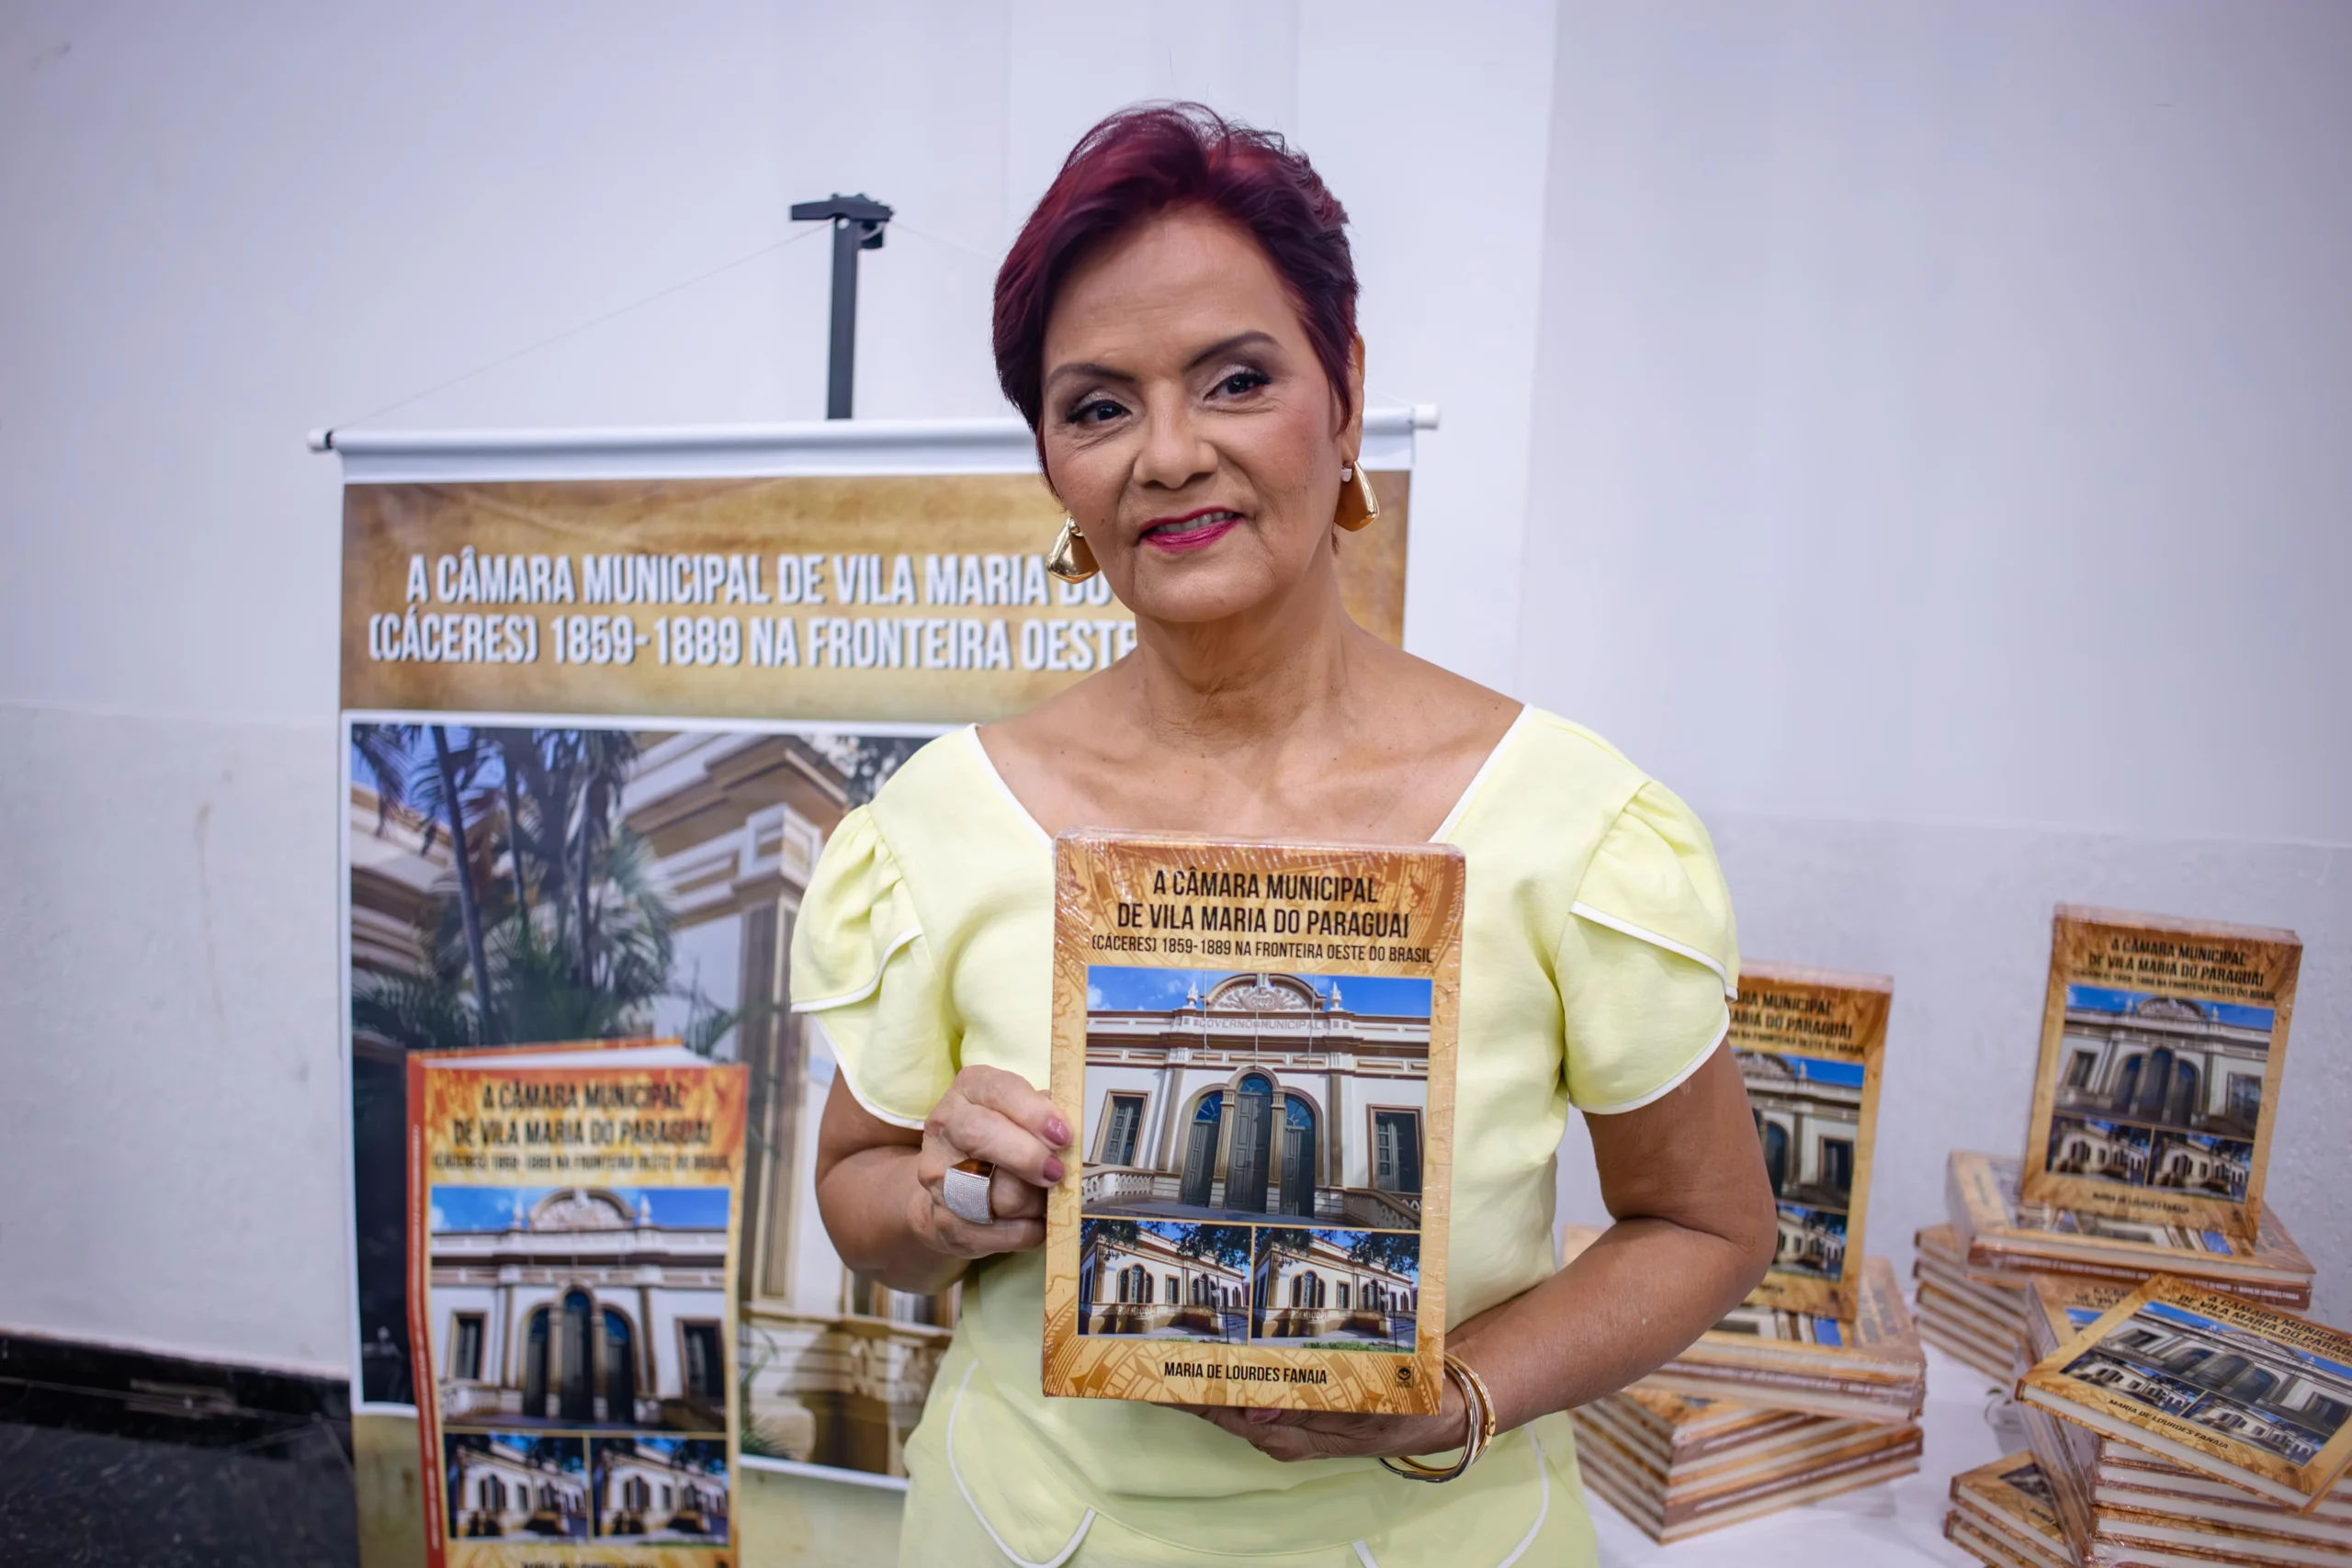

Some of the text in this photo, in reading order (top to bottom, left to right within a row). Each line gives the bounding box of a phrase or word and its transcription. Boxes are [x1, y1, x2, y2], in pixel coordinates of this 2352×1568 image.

[406, 554, 429, 604] A
[436, 546, 576, 604] CÂMARA
[582, 554, 770, 604] MUNICIPAL
[777, 555, 825, 605] DE
[832, 555, 917, 606] VILA
[925, 555, 1050, 607] MARIA
[369, 605, 539, 663] (CÁCERES)
[550, 614, 741, 667] 1859-1889
[749, 616, 799, 668] NA
[808, 616, 1013, 671] FRONTEIRA
[1153, 866, 1379, 904] A CÂMARA MUNICIPAL
[1118, 903, 1409, 939] DE VILA MARIA DO PARAGUAI
[1091, 931, 1434, 964] (CÁCERES) 1859-1889 NA FRONTEIRA OESTE DO BRASIL
[1261, 1019, 1322, 1031] MUNICIPAL
[2280, 1326, 2301, 1339] DO
[2282, 1319, 2352, 1348] MUNICIPA
[1164, 1361, 1328, 1385] MARIA DE LOURDES FANAIA
[2109, 1399, 2229, 1450] MARIA DE LOURDES FANAIA
